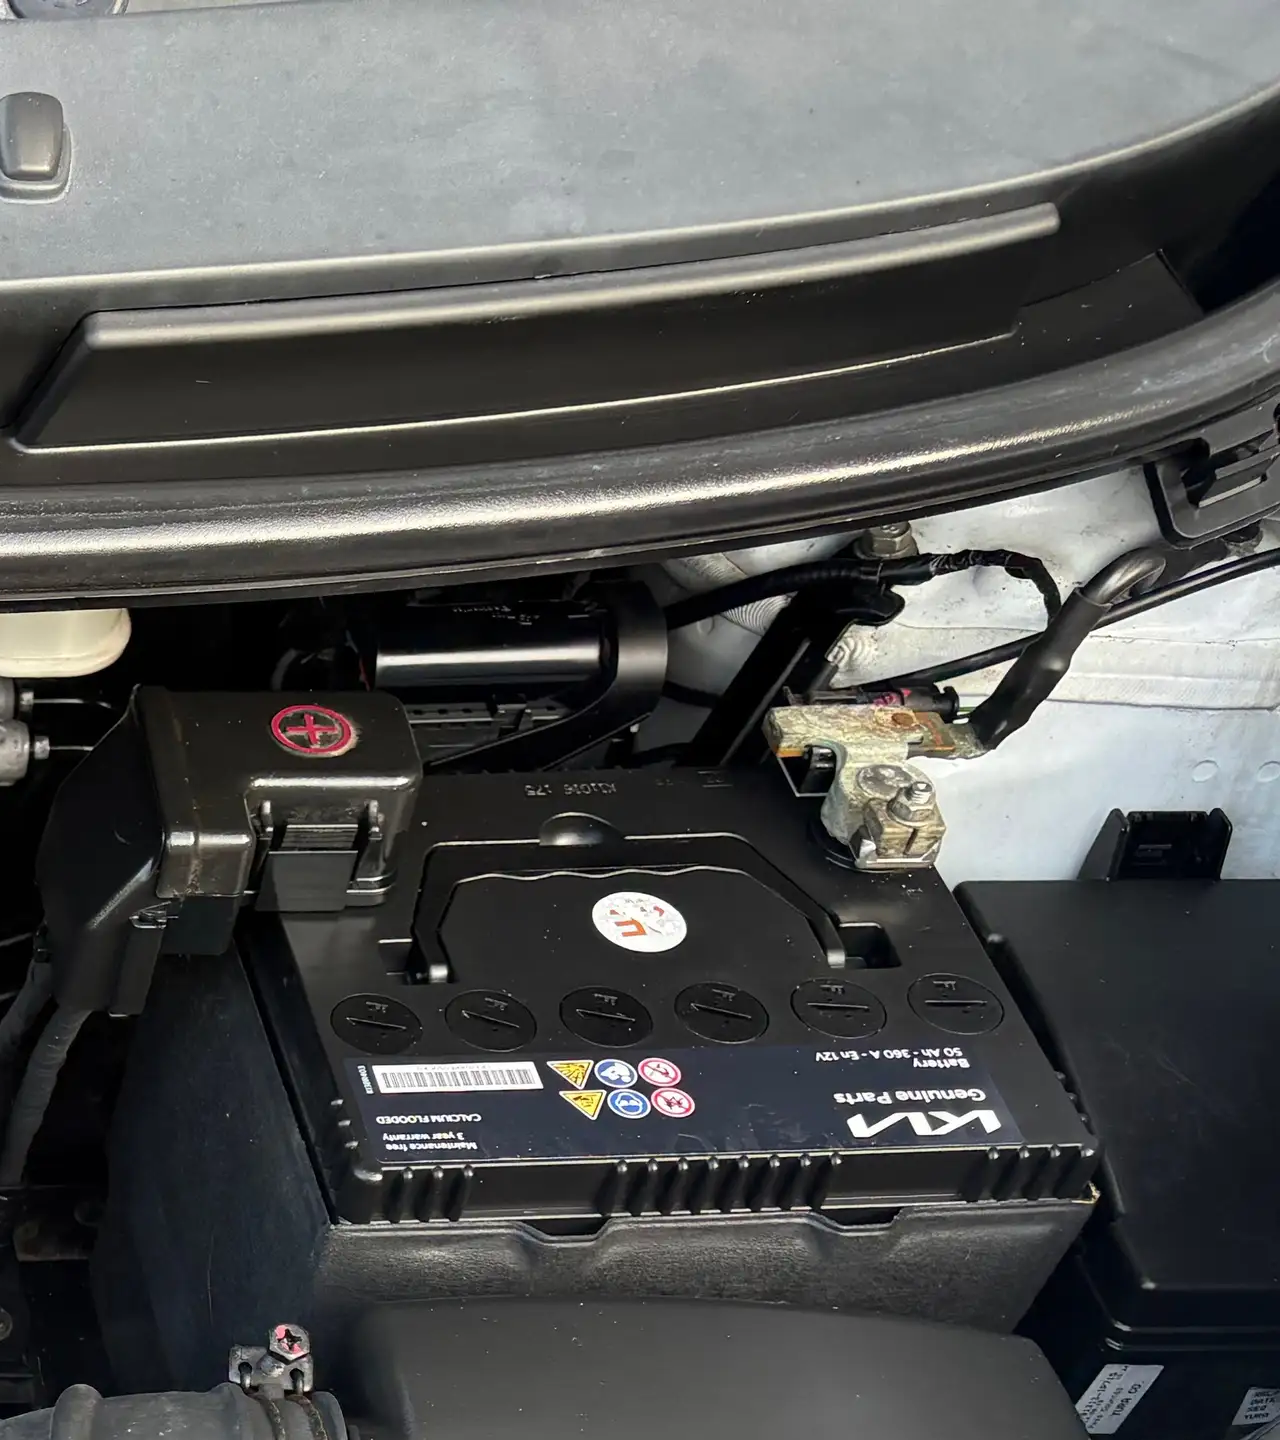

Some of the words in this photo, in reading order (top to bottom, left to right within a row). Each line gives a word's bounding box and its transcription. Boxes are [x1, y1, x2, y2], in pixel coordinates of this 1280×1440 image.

[815, 1050, 839, 1062] 12V
[840, 1049, 858, 1061] En
[868, 1049, 880, 1059] A
[883, 1048, 911, 1060] 360
[921, 1047, 941, 1058] Ah
[943, 1046, 963, 1059] 50
[912, 1056, 971, 1069] Battery
[833, 1091, 893, 1106] Parts
[894, 1087, 986, 1104] Genuine
[375, 1115, 429, 1125] FLOODED
[430, 1113, 482, 1123] CALCIUM
[382, 1132, 430, 1142] warranty
[431, 1130, 455, 1141] year
[456, 1131, 464, 1141] 3
[385, 1142, 408, 1152] free
[409, 1141, 478, 1151] Maintenance
